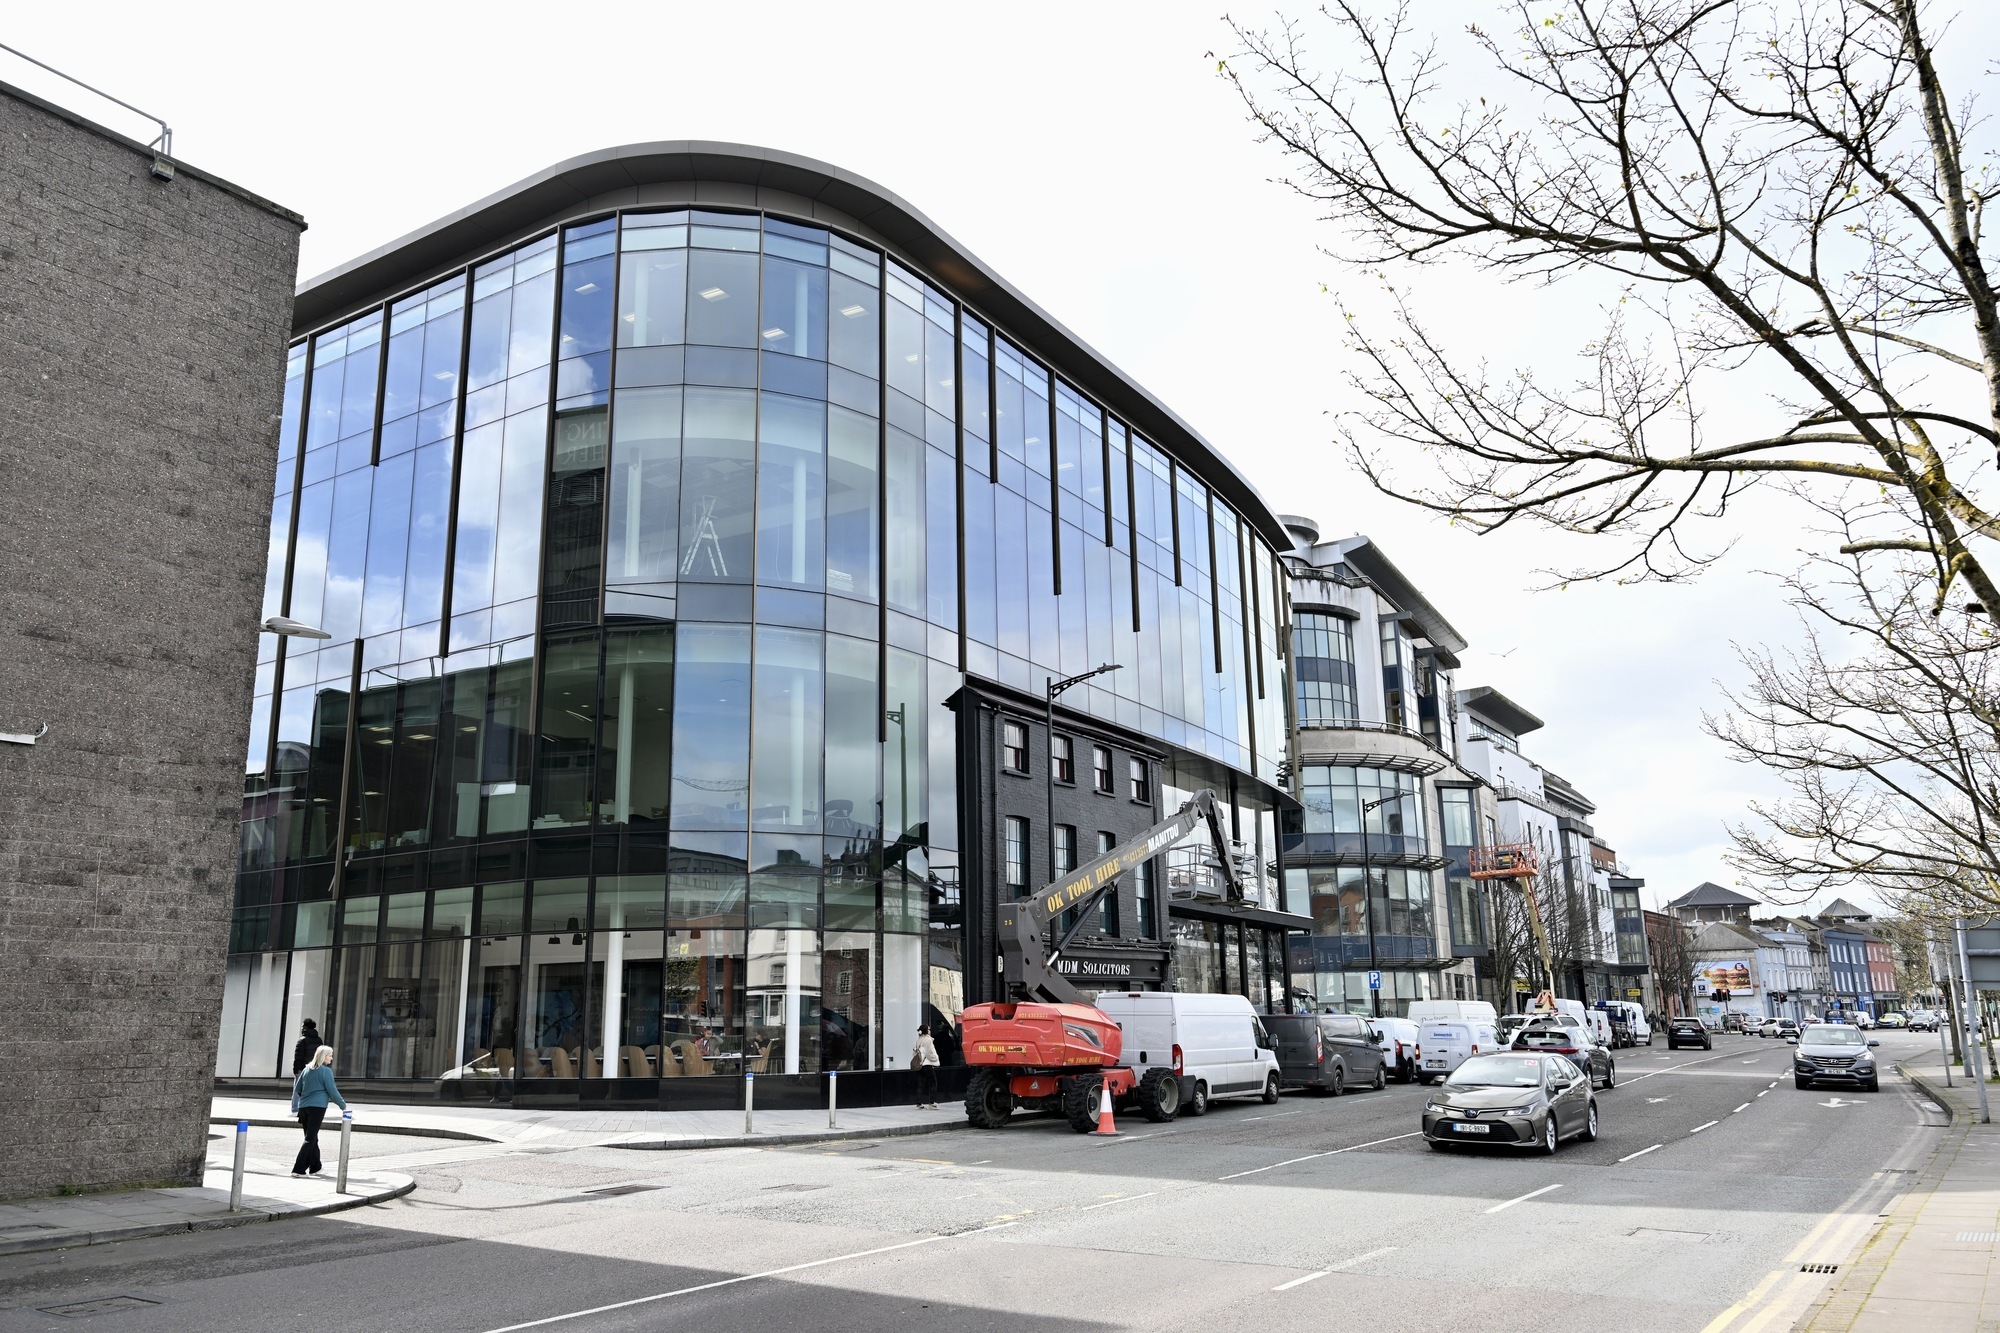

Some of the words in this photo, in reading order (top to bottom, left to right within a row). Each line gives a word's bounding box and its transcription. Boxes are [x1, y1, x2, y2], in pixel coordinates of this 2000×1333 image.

[1148, 823, 1179, 853] MANITOU
[1047, 891, 1064, 913] OK
[1066, 874, 1094, 901] TOOL
[1095, 857, 1121, 884] HIRE
[1057, 960, 1078, 974] MDM
[1082, 961, 1131, 976] SOLICITORS
[1370, 972, 1379, 984] P
